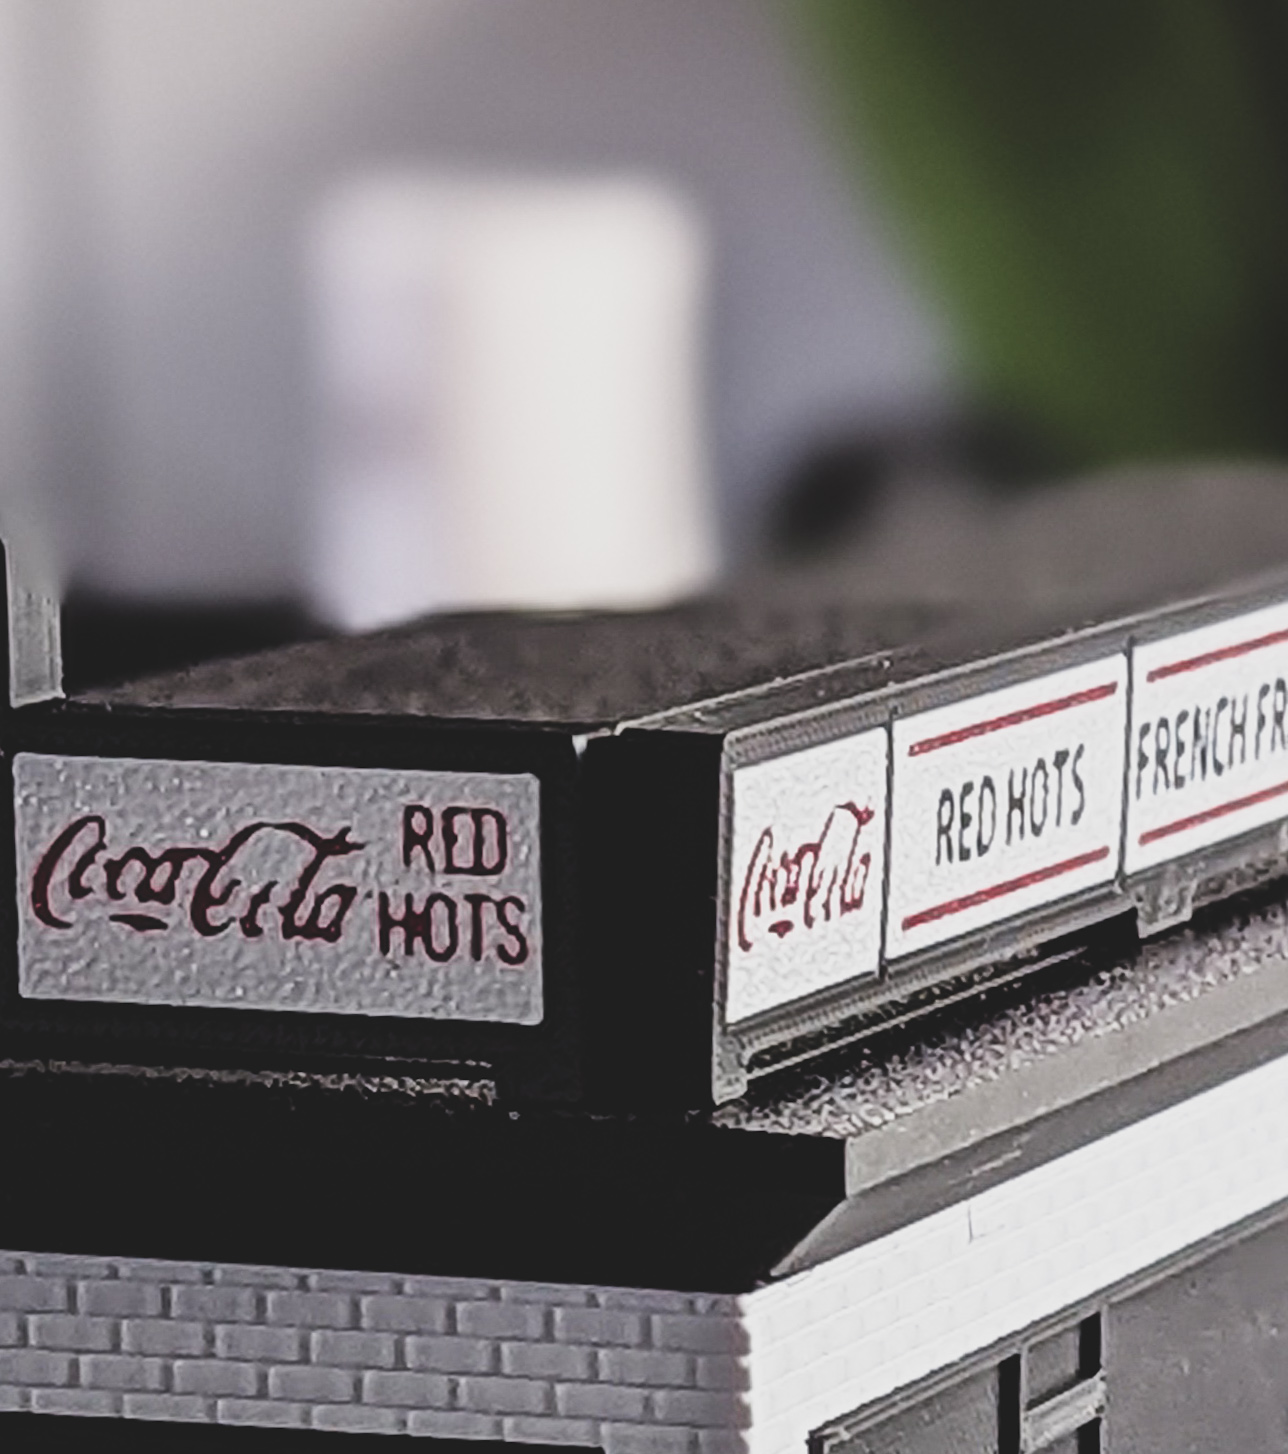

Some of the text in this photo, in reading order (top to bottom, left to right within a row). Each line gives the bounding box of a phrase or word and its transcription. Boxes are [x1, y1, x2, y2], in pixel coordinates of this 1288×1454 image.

[1136, 694, 1249, 800] FRENCH
[402, 804, 508, 876] RED
[935, 743, 1086, 867] RED HOTS
[378, 891, 529, 966] HOTS
